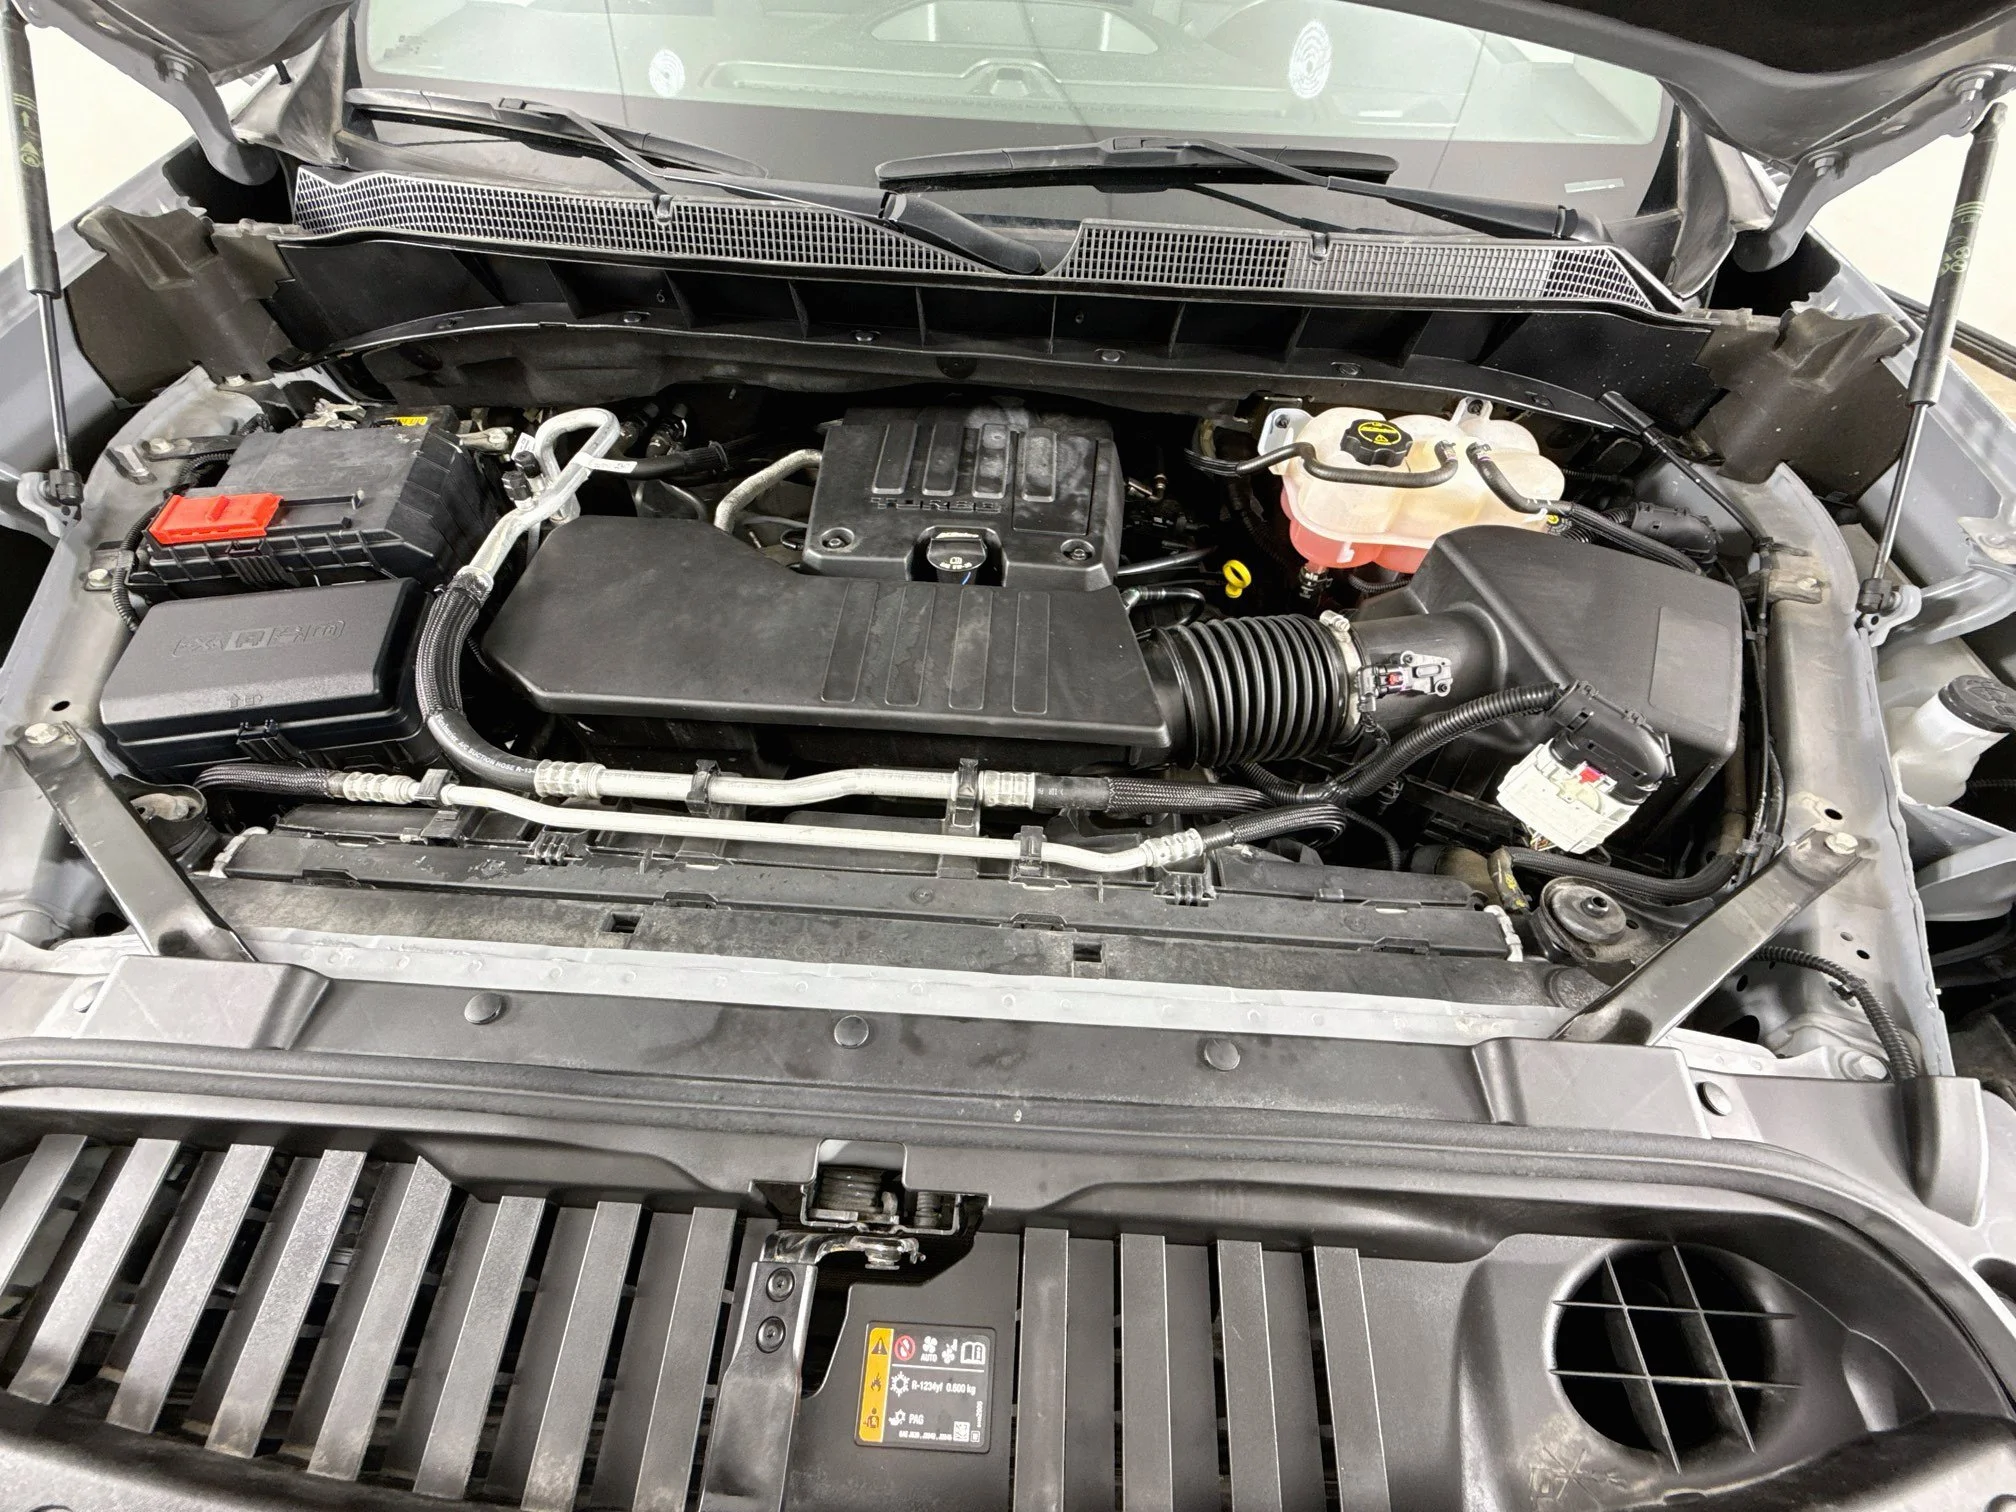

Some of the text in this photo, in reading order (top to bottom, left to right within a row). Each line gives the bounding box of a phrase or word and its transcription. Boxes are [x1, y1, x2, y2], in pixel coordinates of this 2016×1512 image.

[871, 497, 1000, 513] TURBO
[468, 747, 496, 766] SUCTION
[495, 760, 515, 771] HOSE
[921, 1354, 938, 1362] AUTO
[911, 1380, 943, 1393] R-1234yf
[967, 1384, 976, 1396] kg
[909, 1414, 924, 1425] PAG
